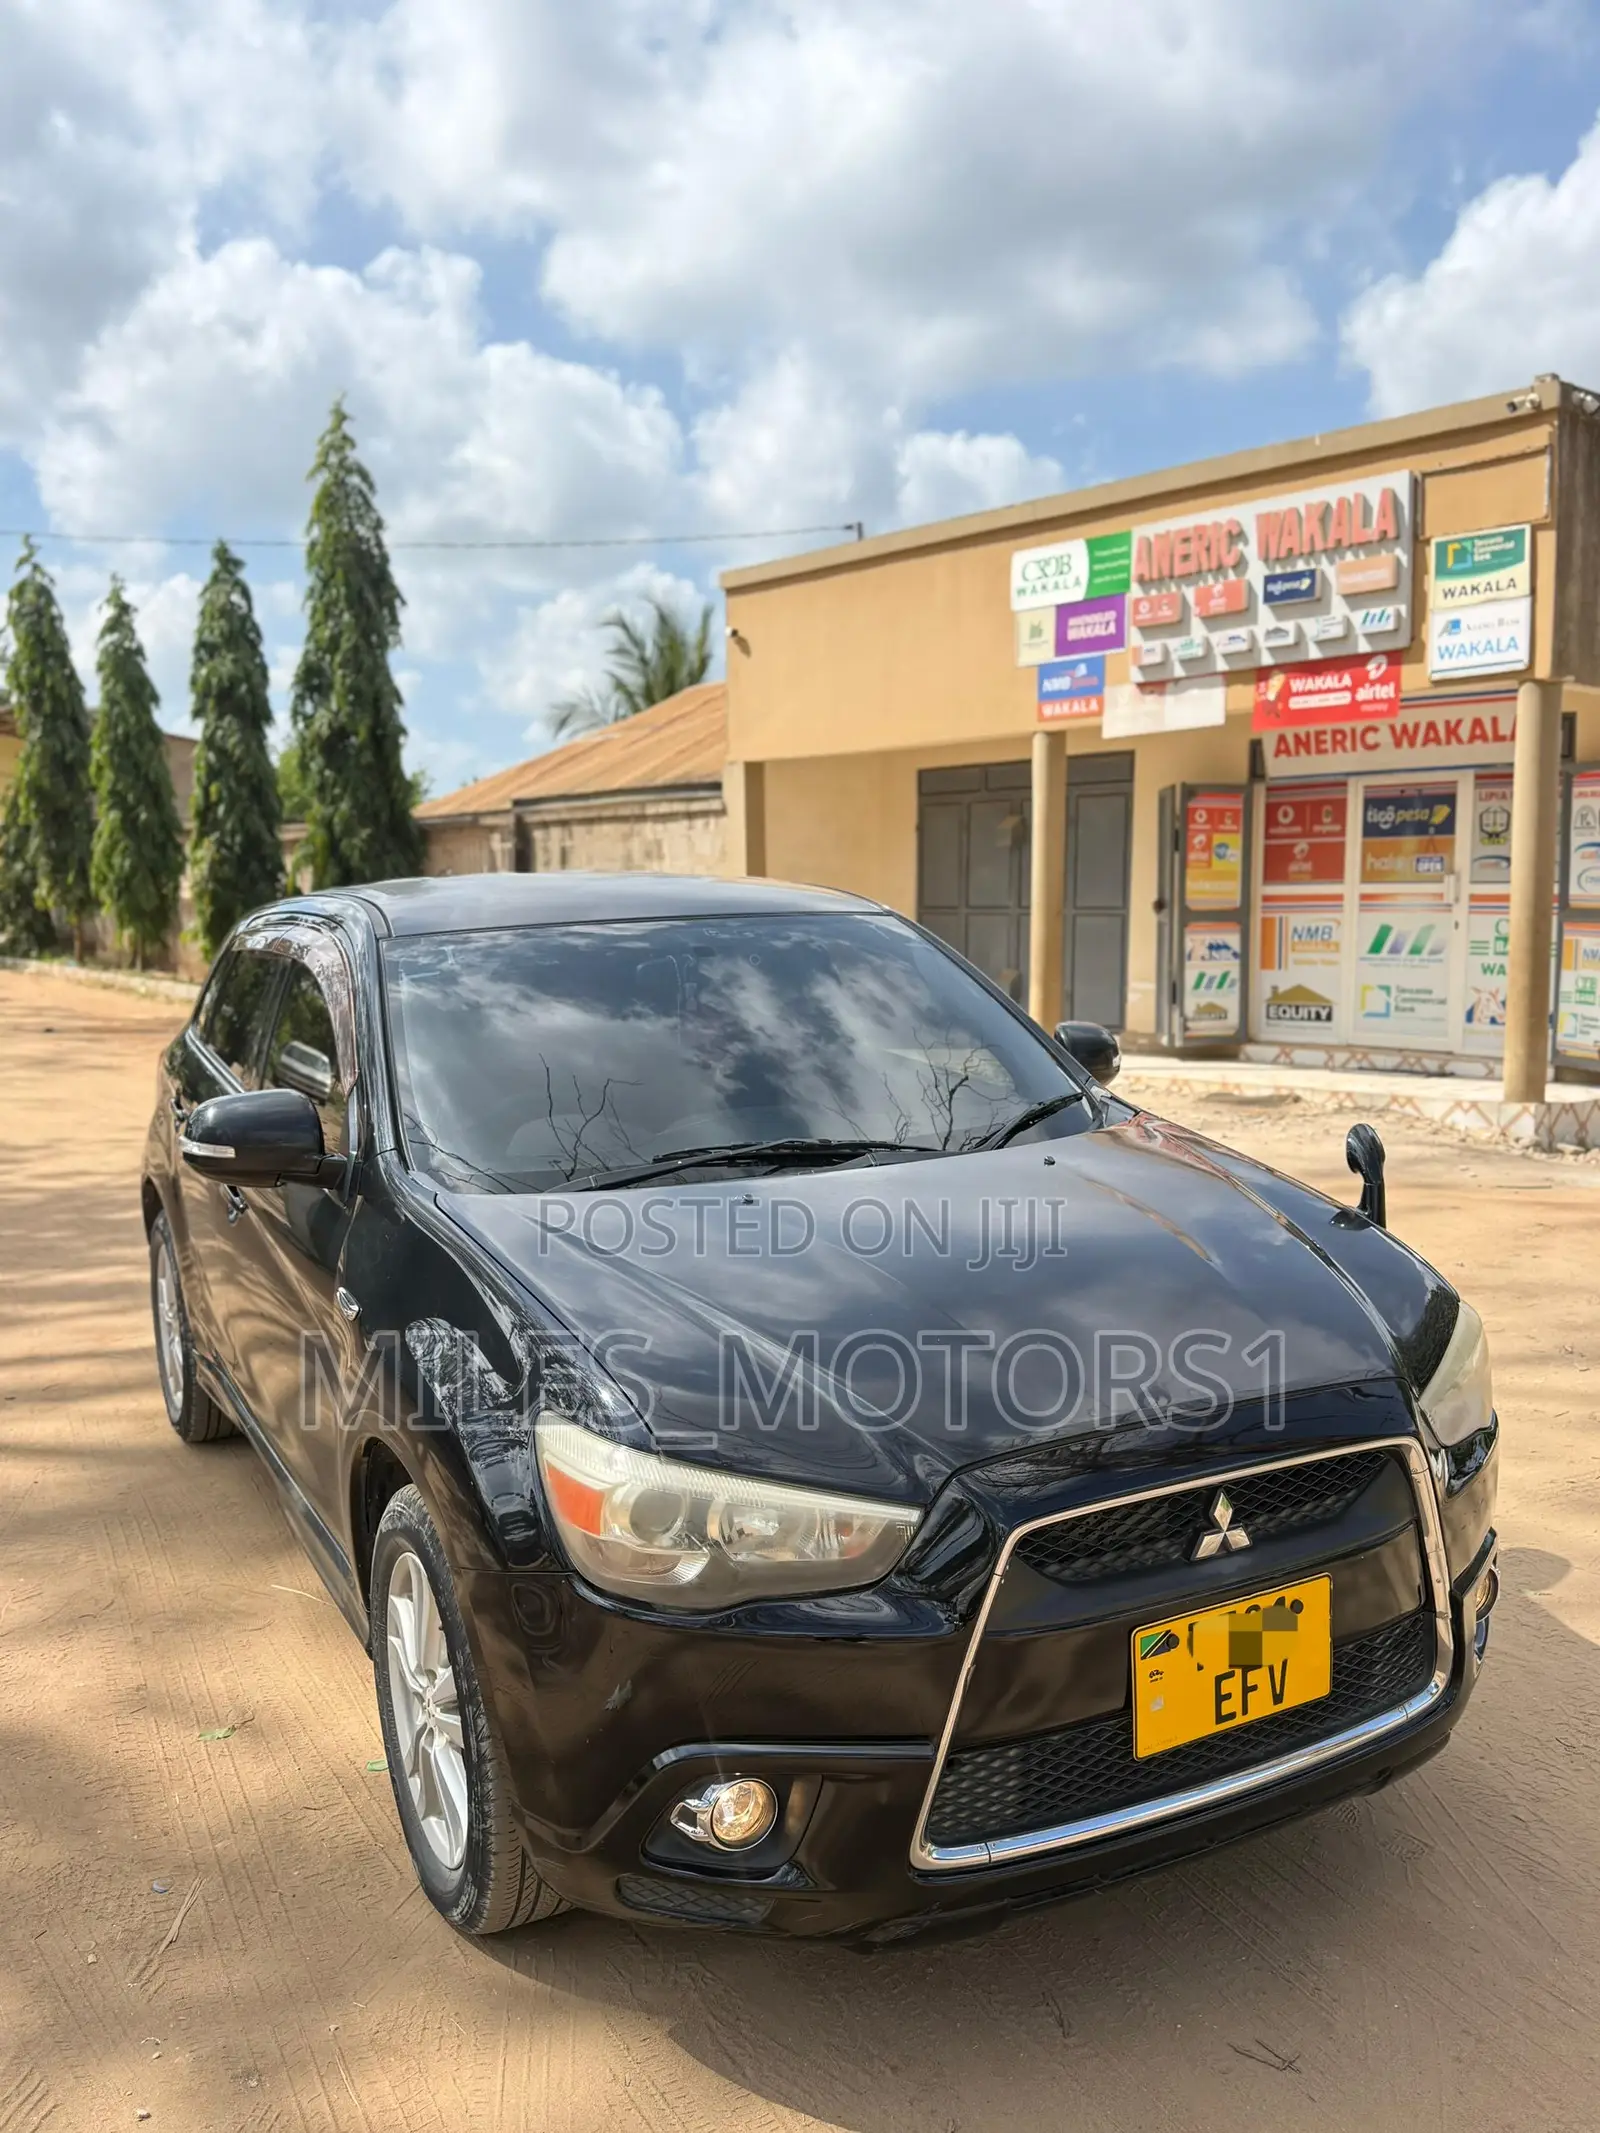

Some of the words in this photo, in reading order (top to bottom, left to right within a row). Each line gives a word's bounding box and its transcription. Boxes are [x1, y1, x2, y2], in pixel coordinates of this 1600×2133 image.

[1132, 518, 1241, 582] ANERIC
[1256, 488, 1400, 561] WAKALA
[1016, 576, 1082, 599] WAKALA
[1442, 577, 1518, 600] WAKALA
[1438, 636, 1519, 660] WAKALA
[1289, 673, 1352, 693] WAKALA
[1355, 681, 1396, 702] airtel
[1041, 701, 1099, 717] WAKALA
[1273, 725, 1381, 759] ANERIC
[1291, 925, 1333, 941] NMB
[1269, 1005, 1331, 1020] EQUITY
[1214, 1657, 1289, 1726] EFV
